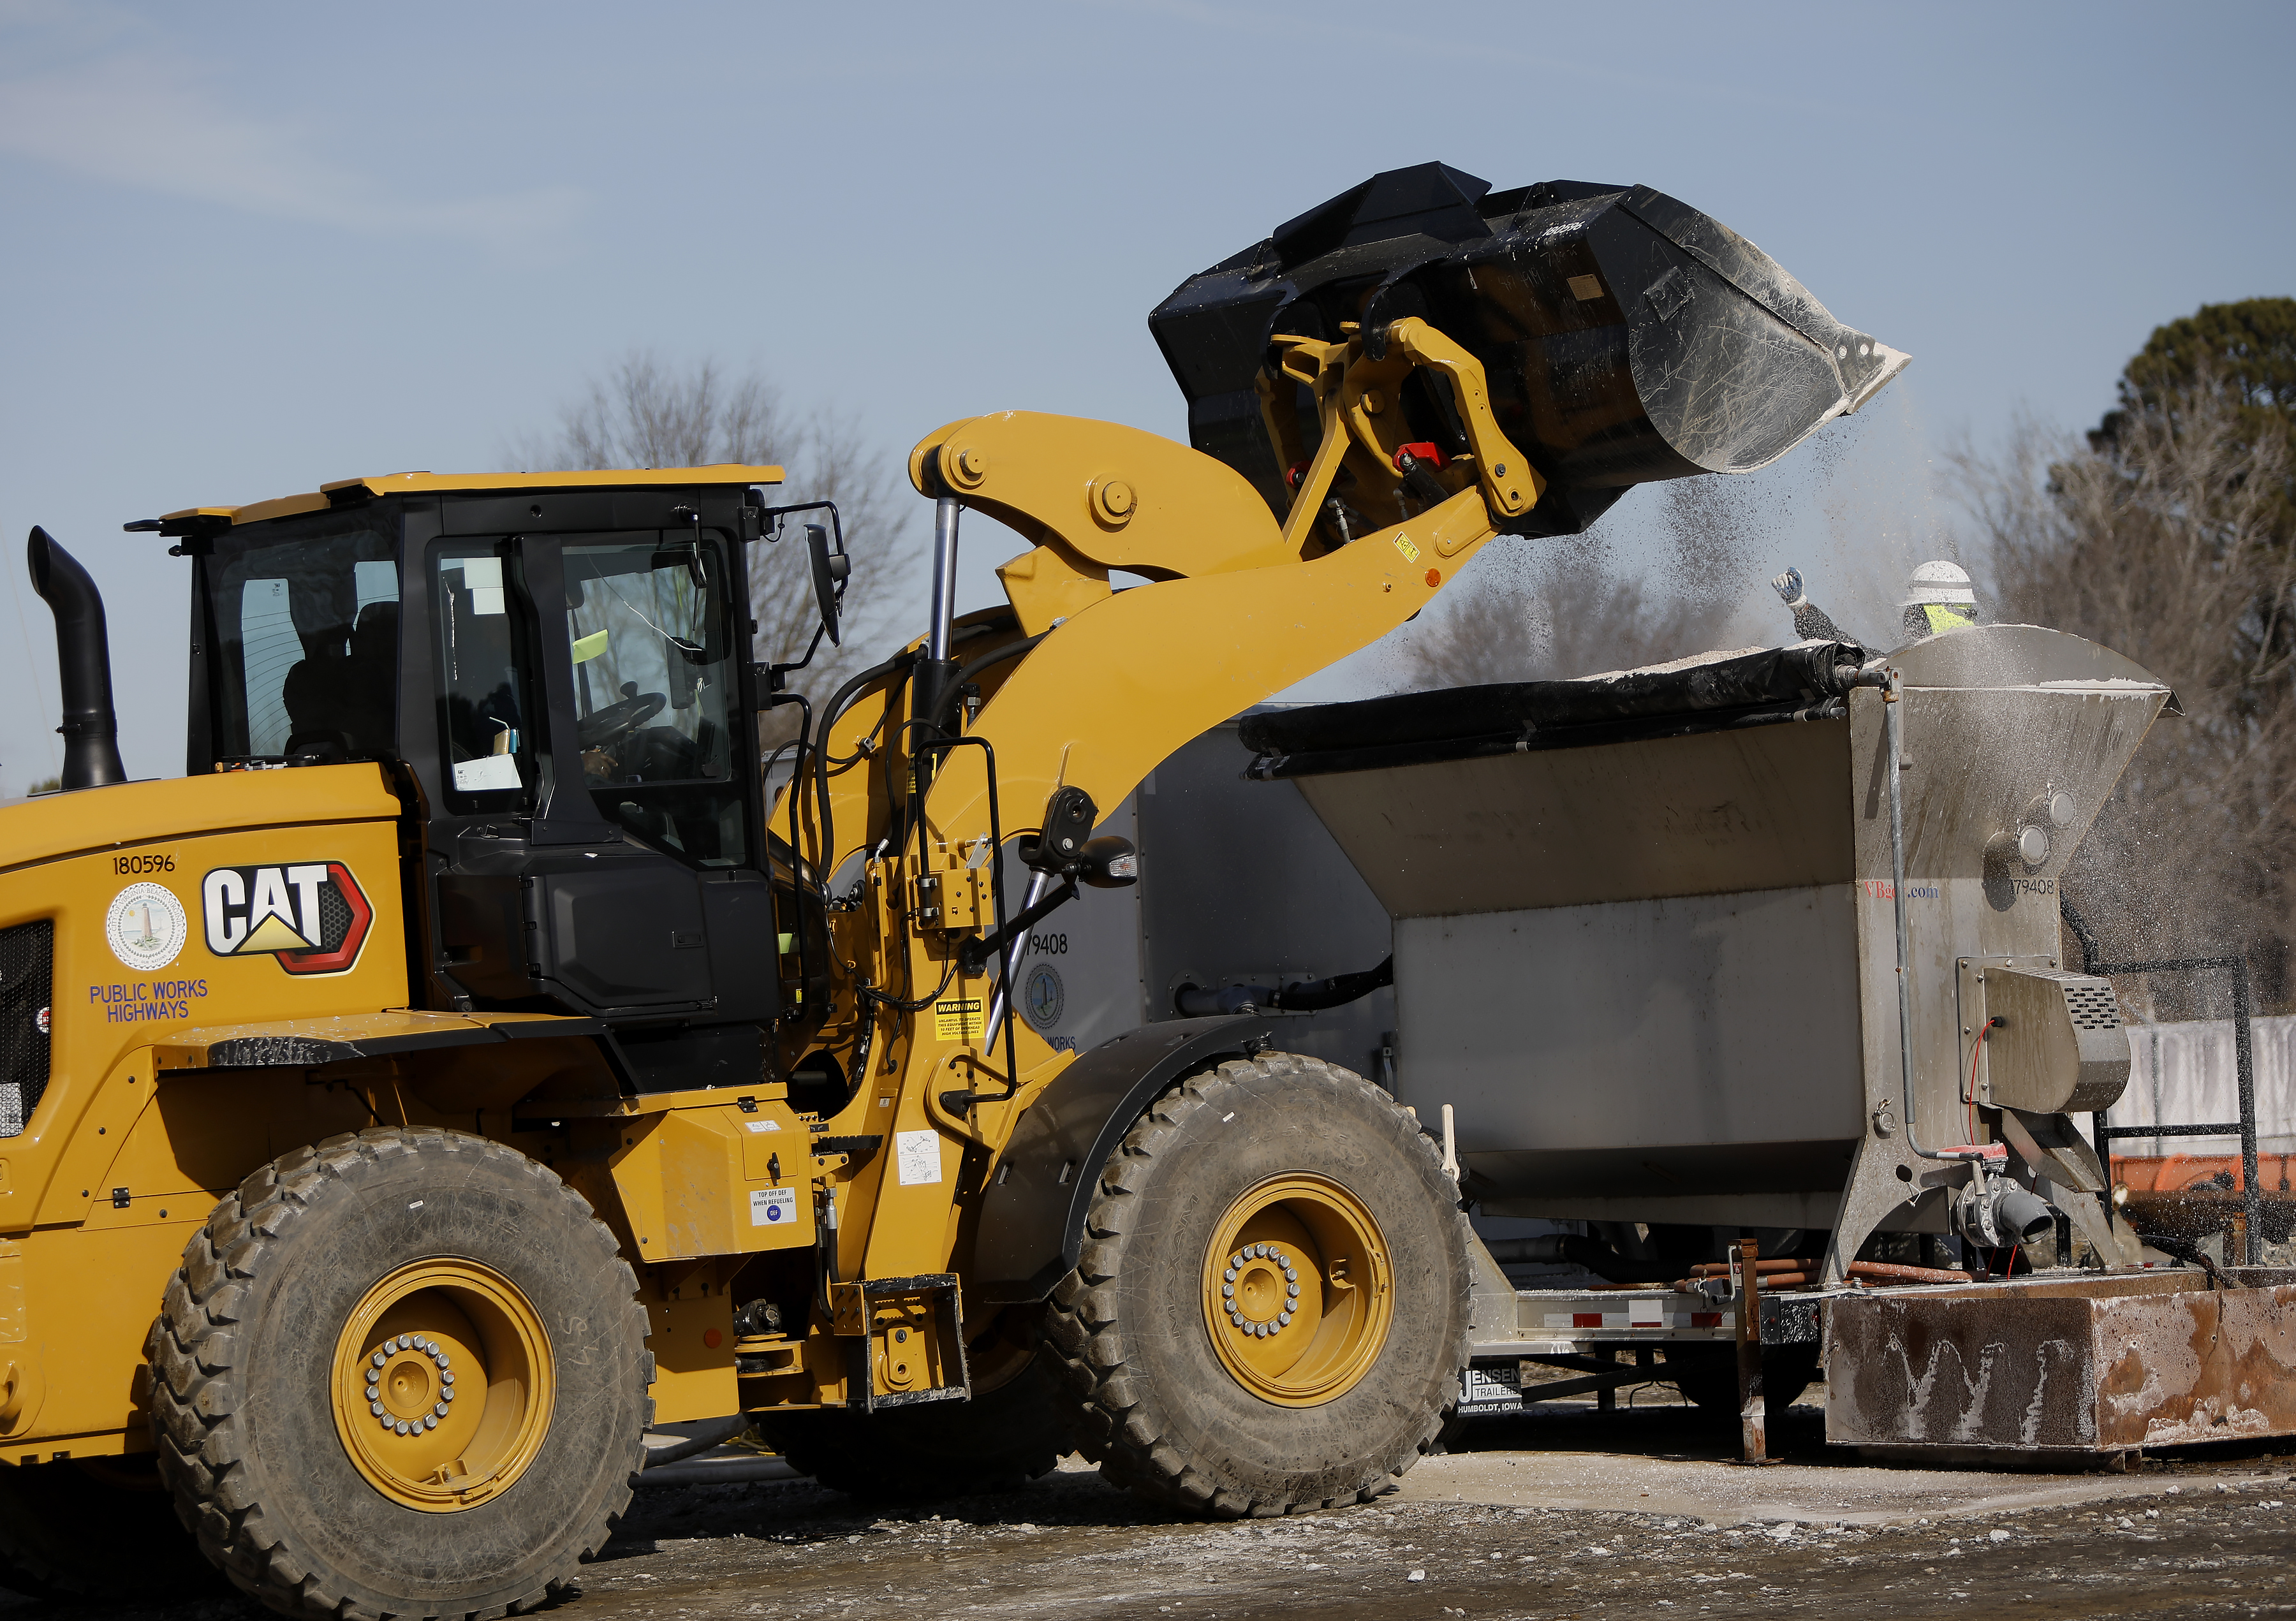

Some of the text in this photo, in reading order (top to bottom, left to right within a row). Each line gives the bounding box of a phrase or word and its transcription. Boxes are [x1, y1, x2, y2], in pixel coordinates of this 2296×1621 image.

[113, 855, 175, 875] 180596
[1864, 881, 1939, 902] VBg.com
[115, 906, 121, 914] OF
[119, 888, 145, 904] VIRGINIA
[147, 888, 167, 900] BEACH
[168, 898, 182, 927] VIRGINIA
[205, 865, 328, 953] CAT
[90, 979, 208, 1004] PUBLIC WORKS
[108, 1001, 189, 1023] HIGHWAYS
[938, 1002, 980, 1012] WARNING
[1048, 1036, 1076, 1051] WORKS
[768, 1197, 793, 1205] REFUELING
[1166, 1192, 1200, 1339] MAXAM
[1458, 1368, 1520, 1403] JENSEN
[1475, 1386, 1518, 1397] TRAILERS
[1458, 1402, 1523, 1413] HUMBOLDT, IOWA
